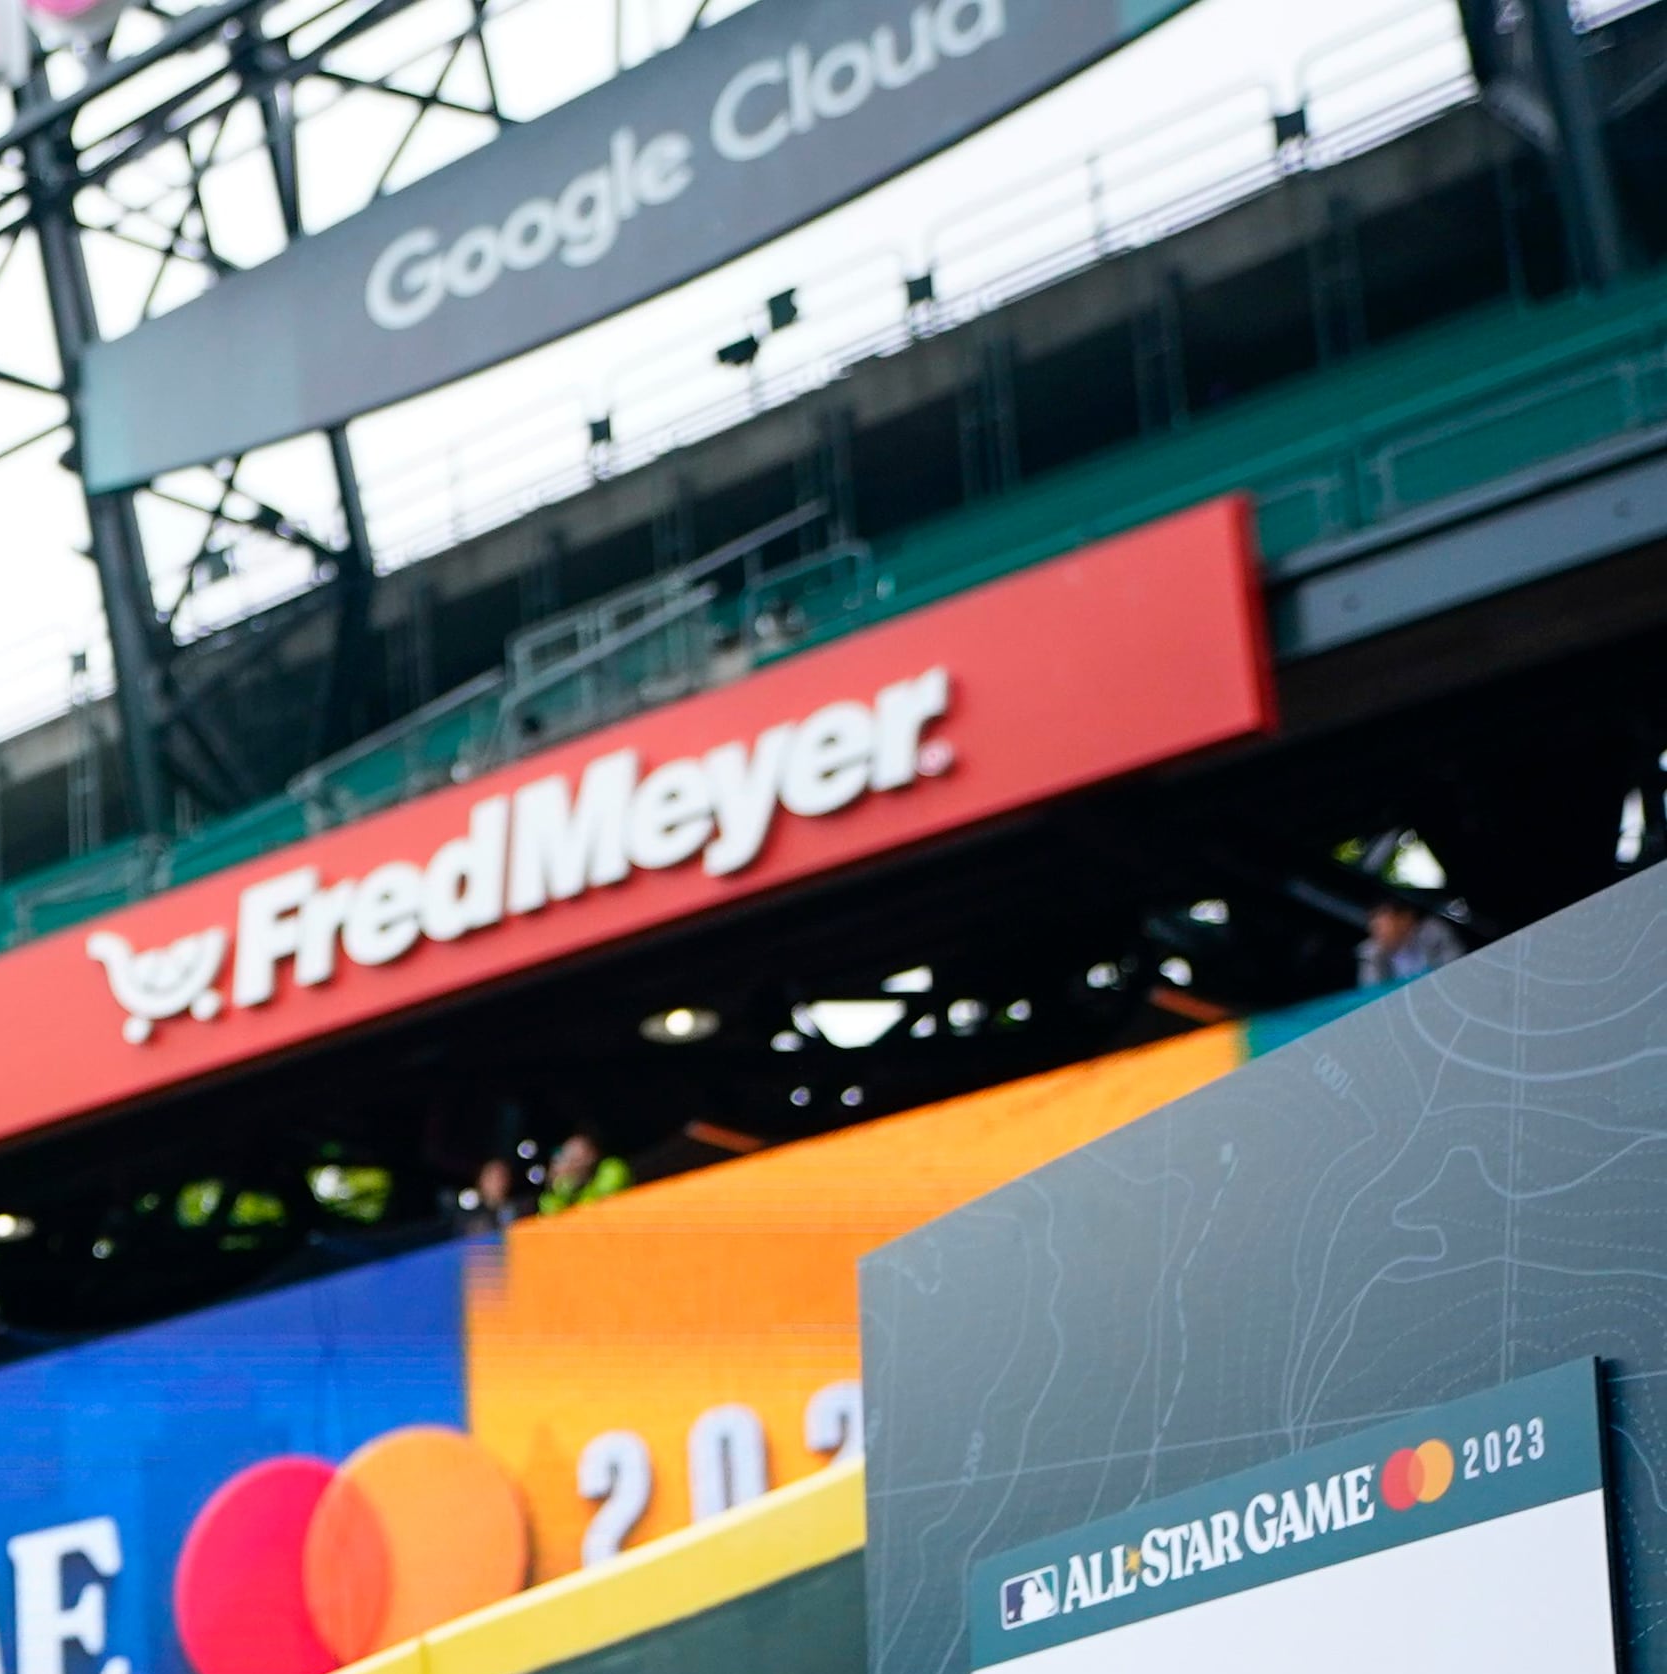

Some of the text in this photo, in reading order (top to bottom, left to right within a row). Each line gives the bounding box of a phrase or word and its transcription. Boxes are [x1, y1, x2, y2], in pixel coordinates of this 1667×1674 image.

[364, 0, 1007, 332] Google Cloud
[1062, 1417, 1545, 1613] ALL STAR GAME 2023
